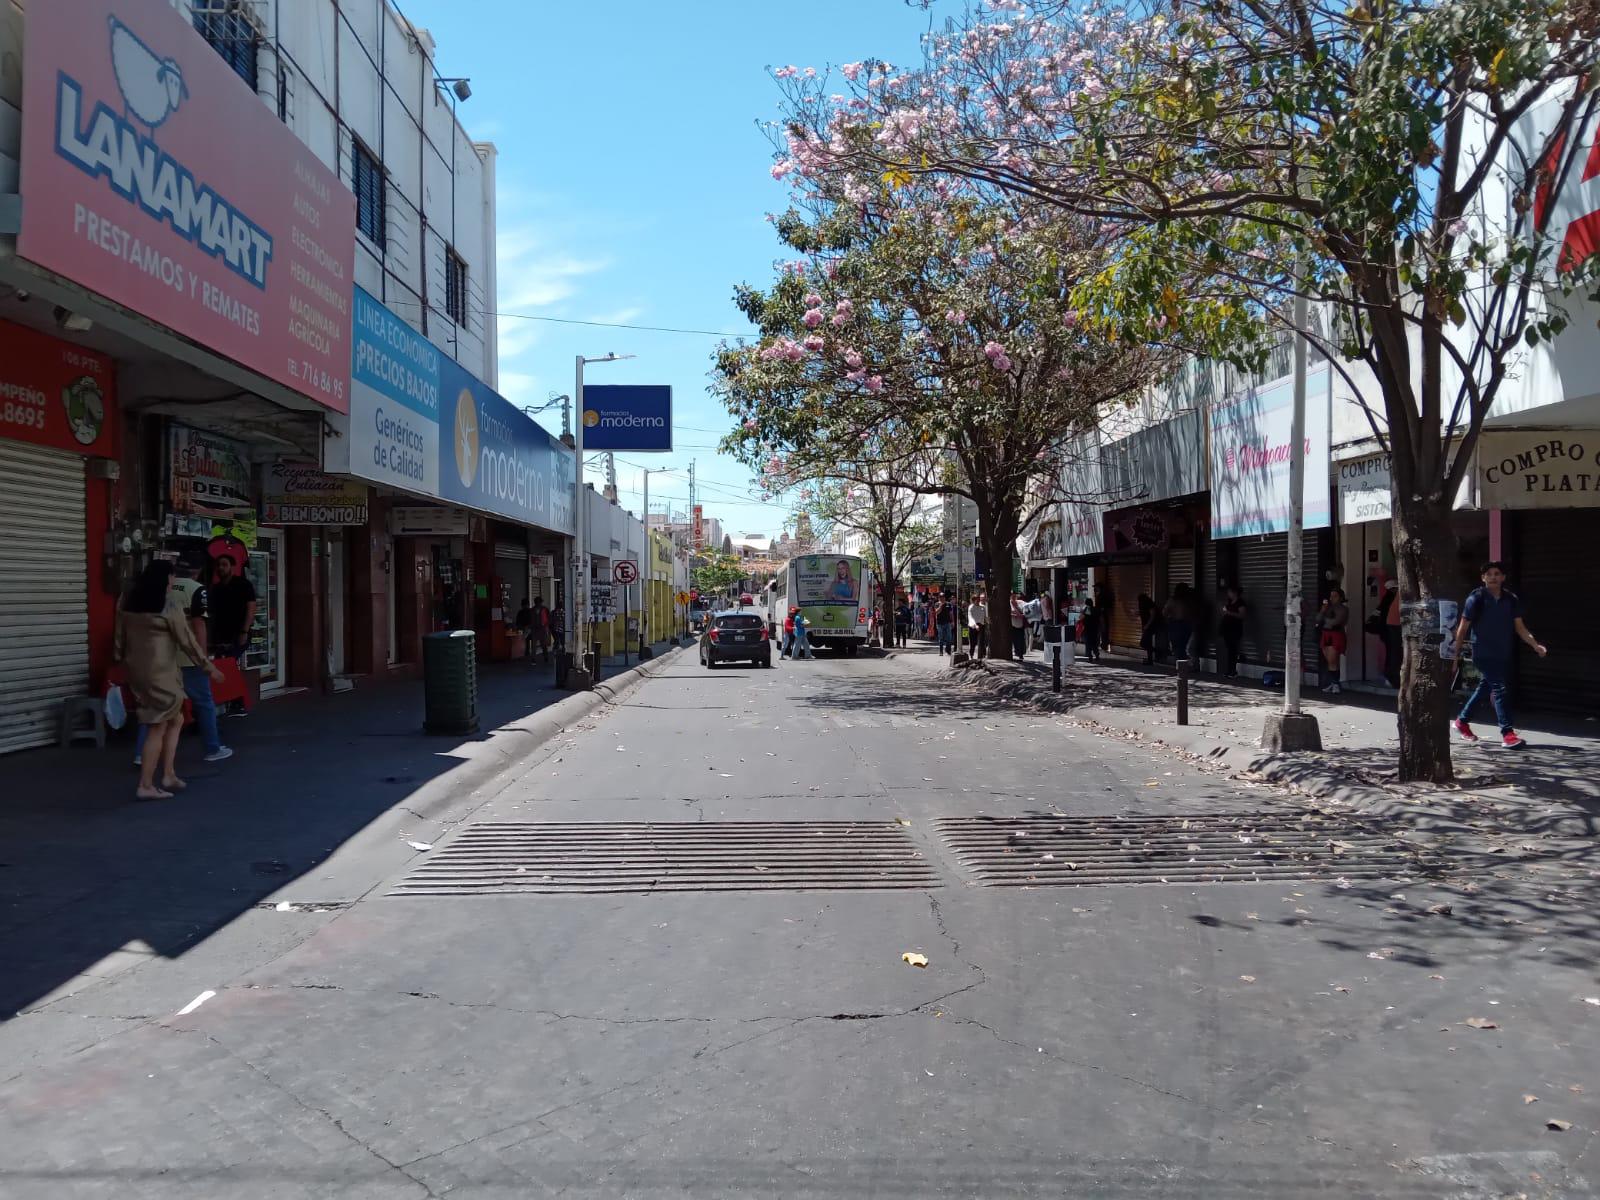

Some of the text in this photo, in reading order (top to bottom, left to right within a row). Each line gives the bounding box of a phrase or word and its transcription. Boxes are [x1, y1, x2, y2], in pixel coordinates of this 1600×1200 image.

[55, 70, 273, 290] LANAMART
[293, 191, 320, 229] AUTOS
[74, 203, 260, 336] PRESTAMOS Y REMATES
[290, 259, 347, 316] HERRAMIENTAS
[289, 294, 341, 341] MAQUINARIA
[358, 298, 438, 376] LINEA ECONOMICA
[302, 360, 318, 387] 716
[320, 371, 331, 393] 86
[333, 377, 343, 399] 95
[356, 339, 437, 409] ¡PRECIOS BAJOS!
[375, 407, 424, 453] Genéricos
[601, 414, 665, 428] moderna
[374, 439, 424, 481] de Calidad
[481, 446, 544, 513] moderna
[1486, 440, 1585, 484] COMPRO
[280, 505, 366, 523] BIEN BONITO!!
